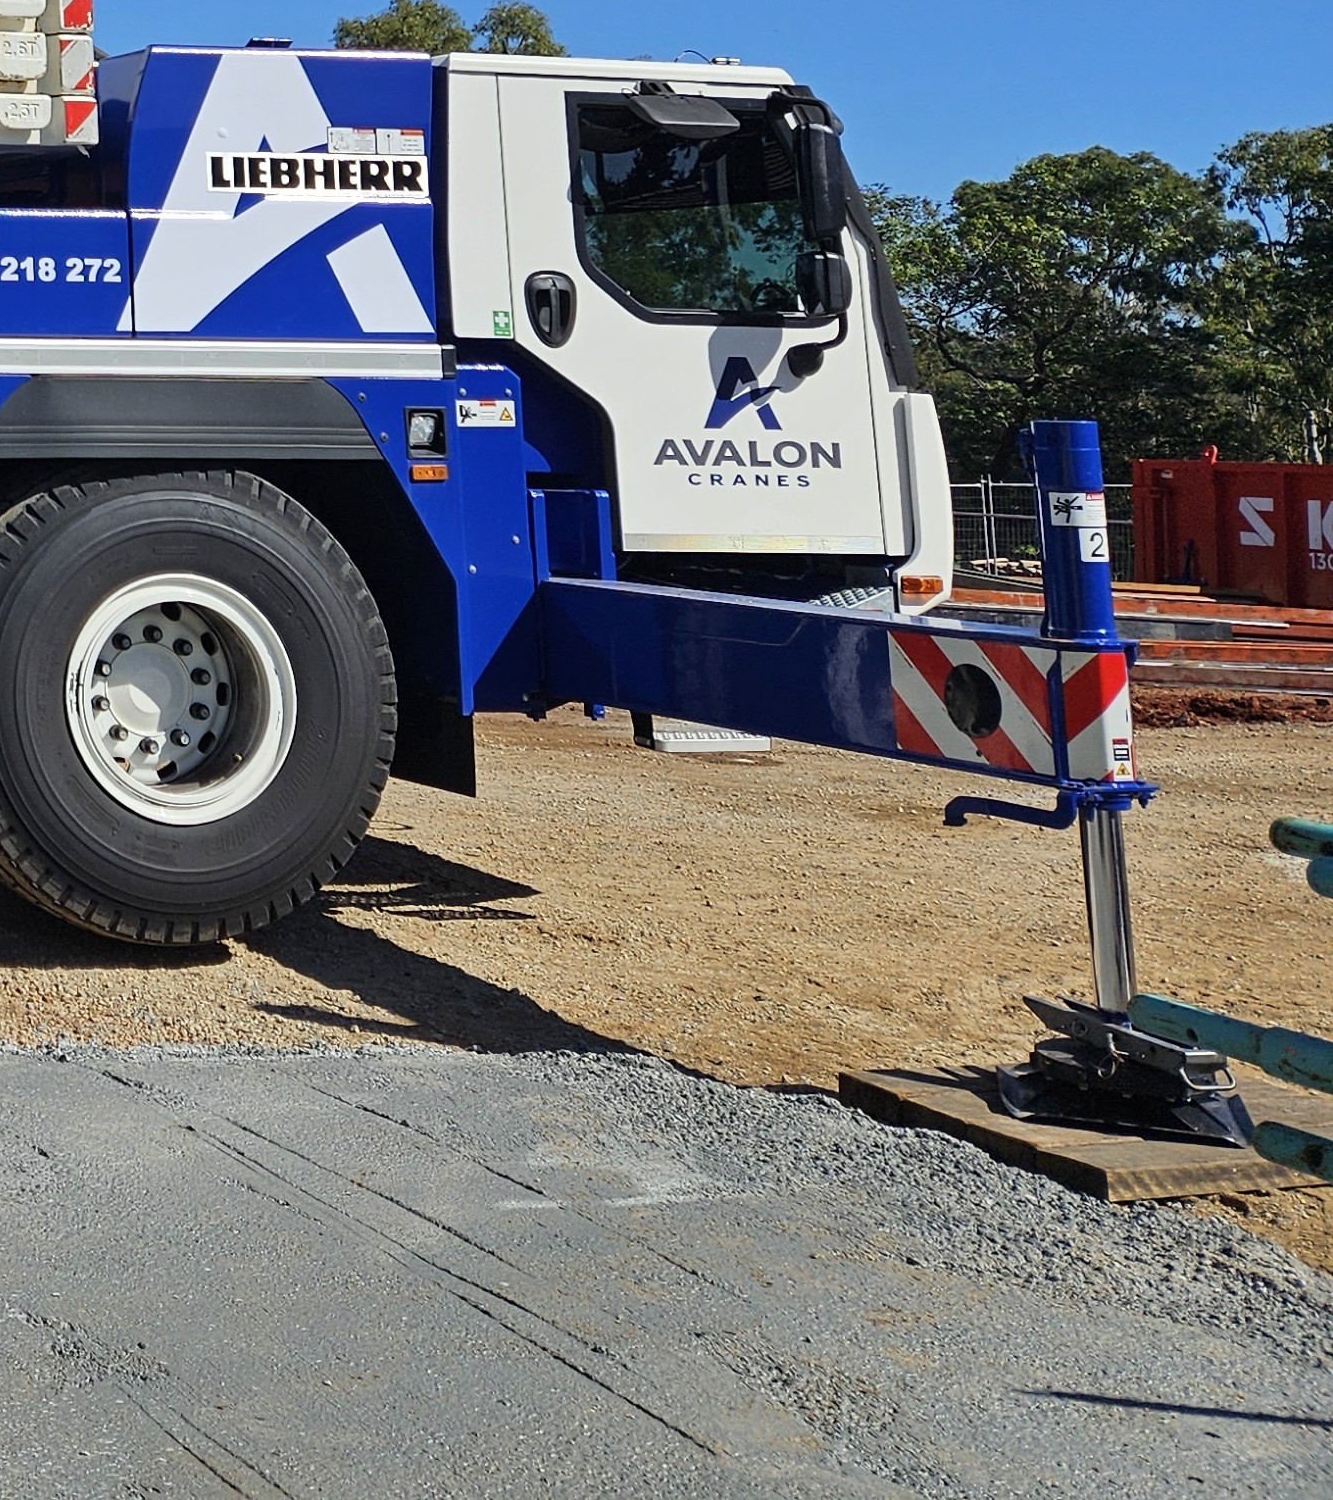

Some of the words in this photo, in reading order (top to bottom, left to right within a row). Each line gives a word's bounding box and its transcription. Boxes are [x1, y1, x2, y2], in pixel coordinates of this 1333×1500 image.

[209, 156, 423, 192] LIEBHERR
[0, 257, 56, 282] 218
[65, 258, 122, 283] 272
[653, 438, 842, 469] AVALON
[688, 474, 811, 487] CRANES
[1090, 532, 1105, 557] 2
